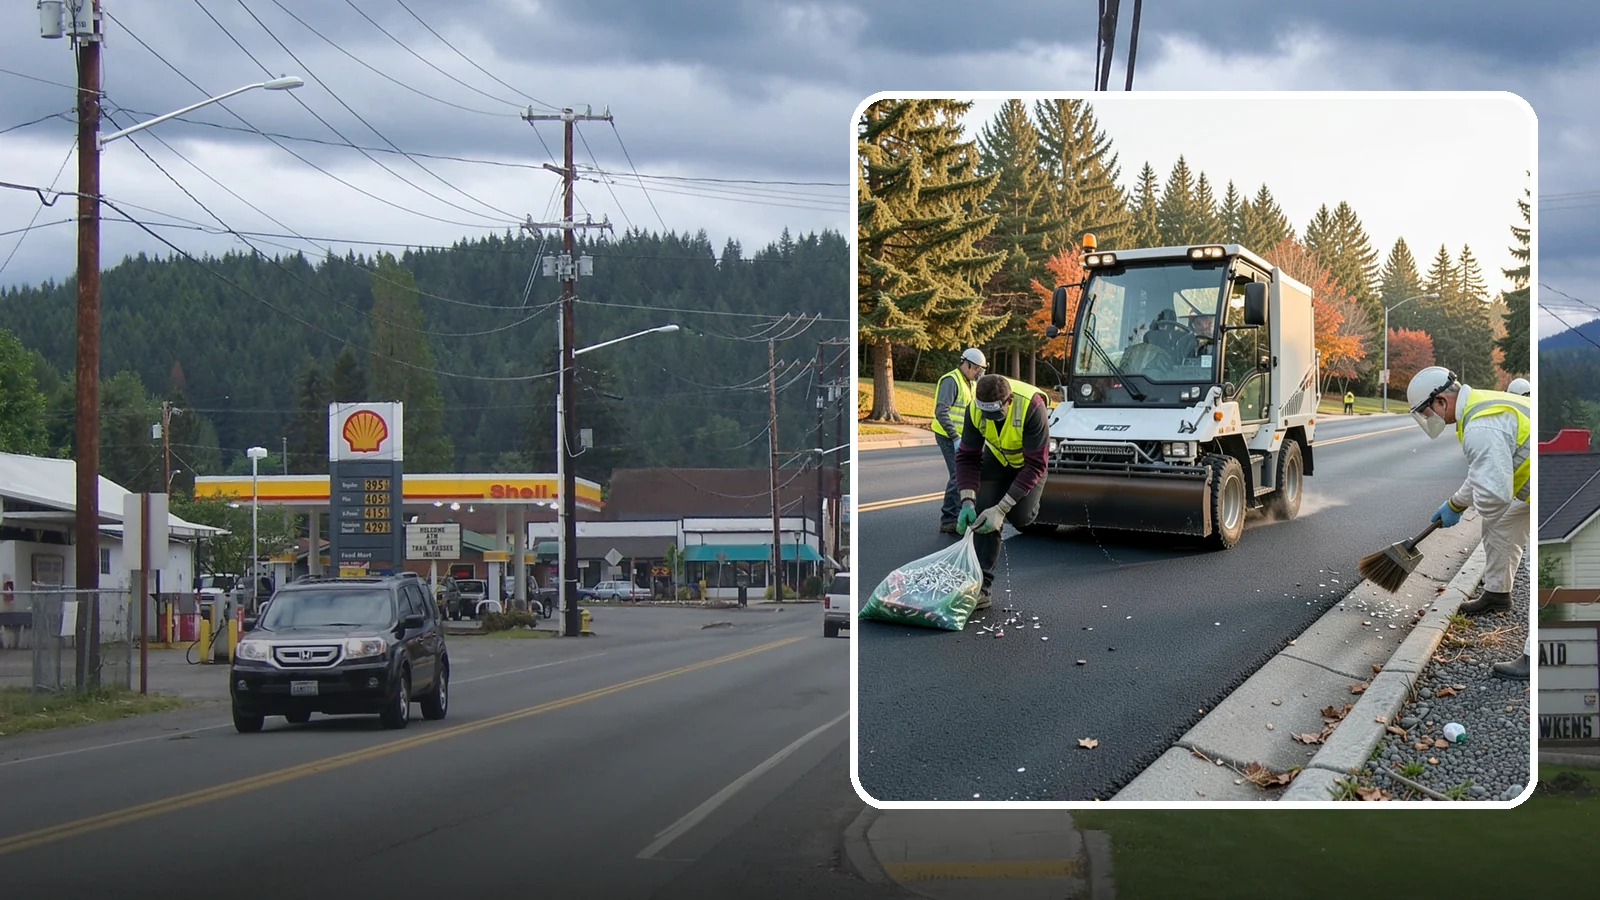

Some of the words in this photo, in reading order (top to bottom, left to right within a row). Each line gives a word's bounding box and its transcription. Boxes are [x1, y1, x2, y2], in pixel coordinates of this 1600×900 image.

[365, 480, 384, 490] 395
[490, 484, 547, 499] Shell
[365, 494, 384, 504] 405
[365, 508, 383, 518] 415
[365, 522, 384, 532] 429
[1539, 642, 1567, 666] AID
